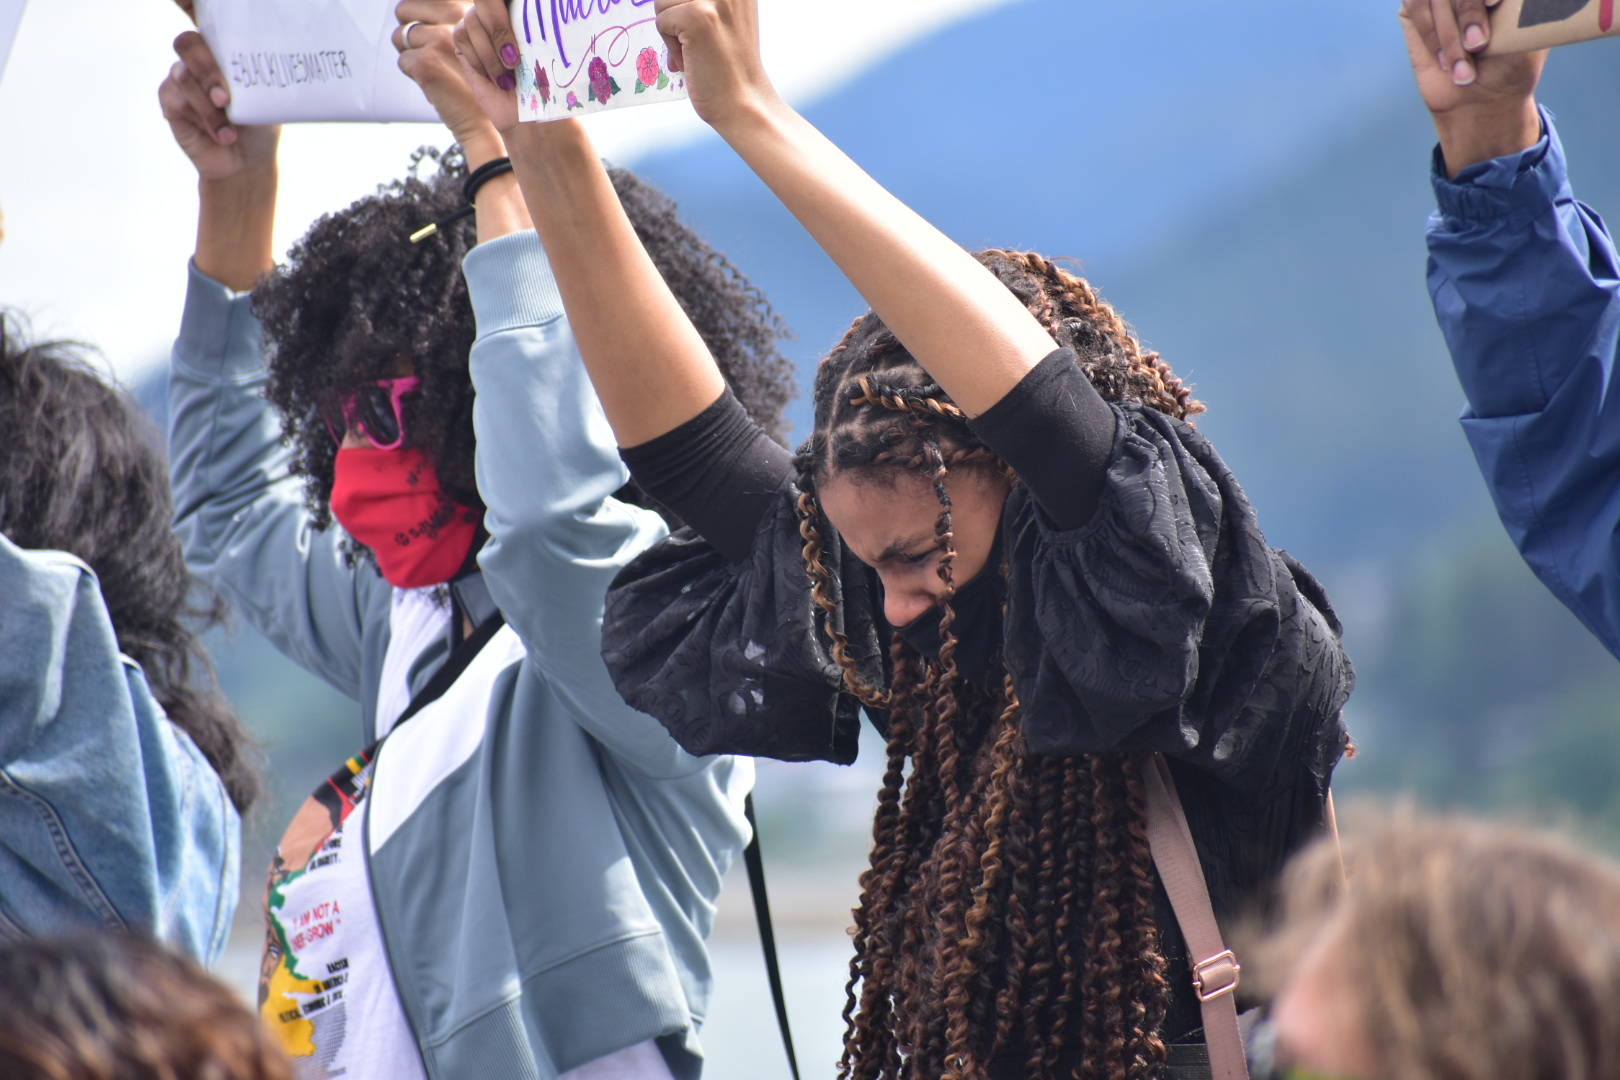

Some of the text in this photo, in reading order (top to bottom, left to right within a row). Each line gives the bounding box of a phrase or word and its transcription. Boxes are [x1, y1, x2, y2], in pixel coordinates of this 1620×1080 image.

[231, 50, 353, 88] #BLACKLIVESMATTER
[312, 903, 331, 920] NOT
[332, 900, 340, 915] A
